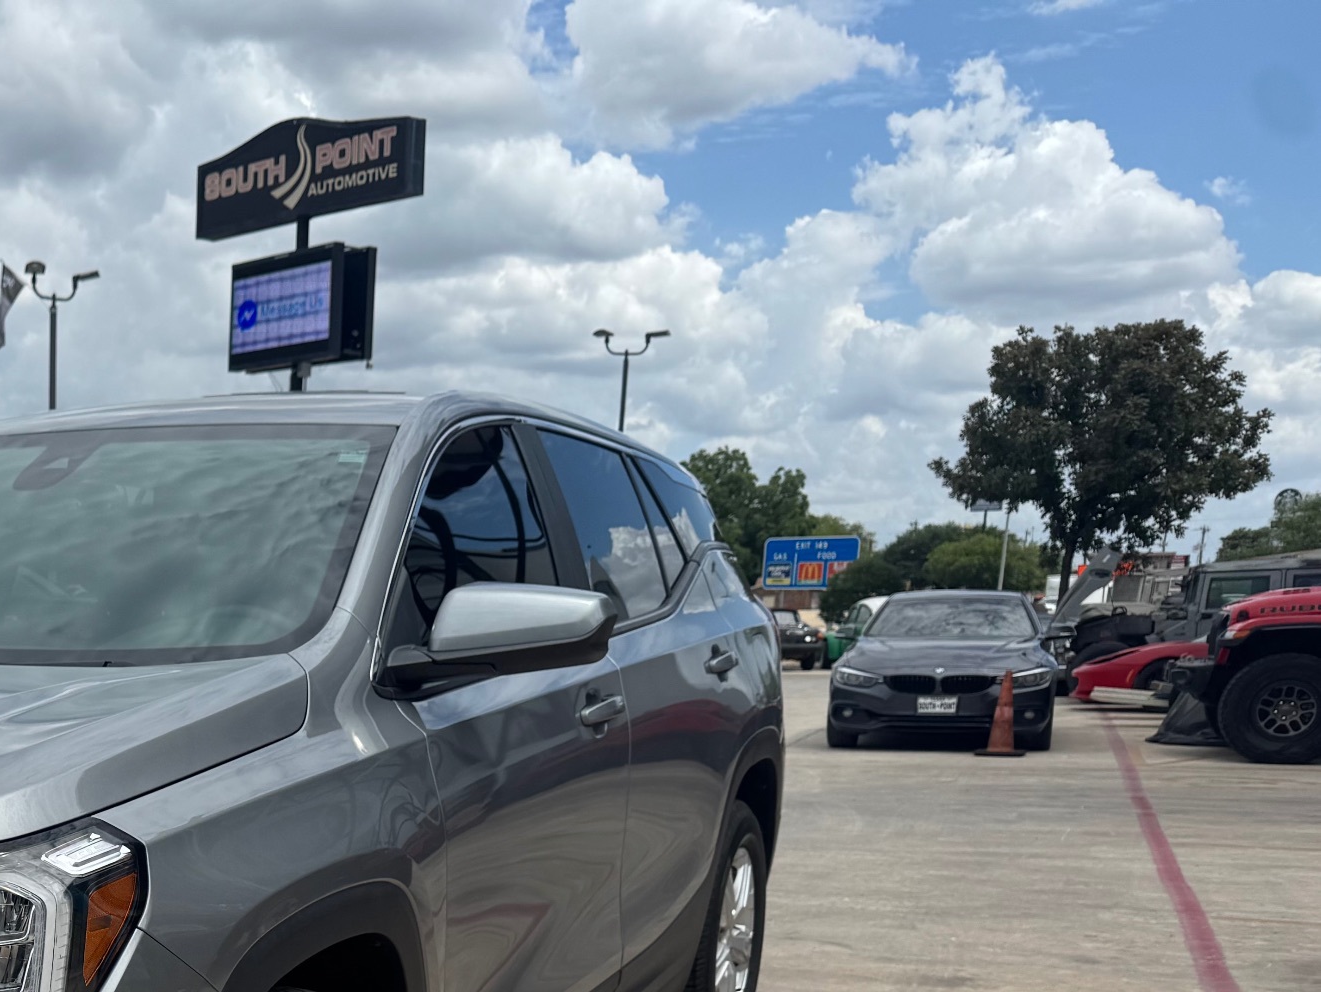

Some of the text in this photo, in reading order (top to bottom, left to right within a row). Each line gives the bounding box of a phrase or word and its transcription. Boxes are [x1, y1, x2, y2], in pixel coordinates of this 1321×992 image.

[204, 126, 397, 201] SOUTH POINT
[307, 163, 398, 197] AUTOMOTIVE
[774, 552, 787, 560] GAS
